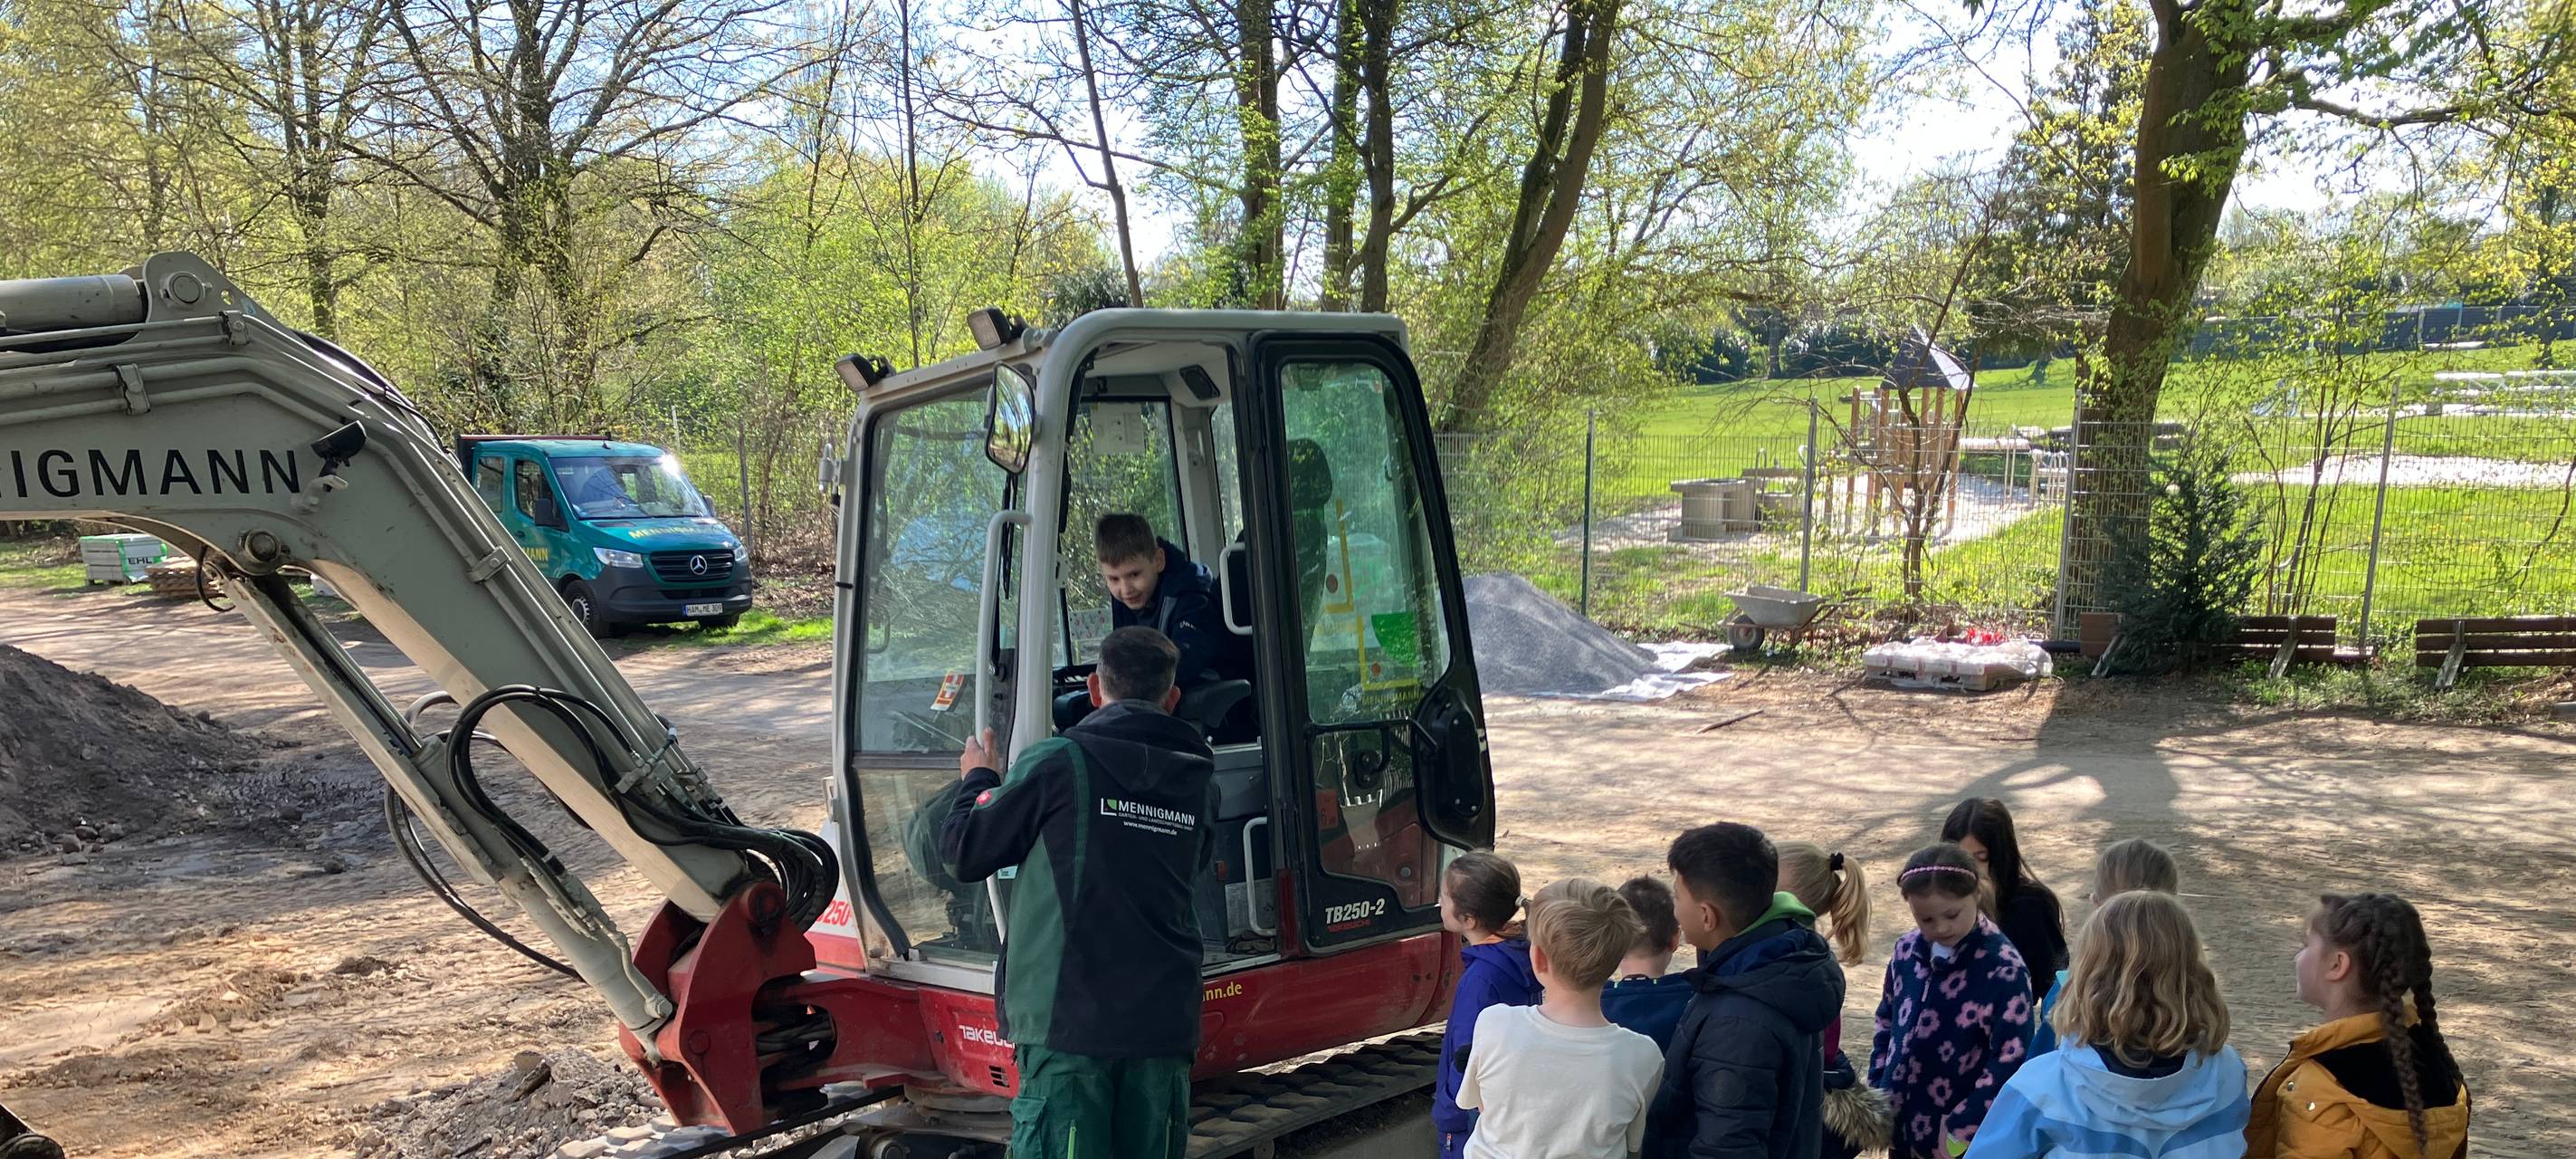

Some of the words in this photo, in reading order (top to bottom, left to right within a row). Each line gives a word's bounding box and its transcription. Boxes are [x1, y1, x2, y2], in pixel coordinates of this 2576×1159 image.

[0, 449, 301, 497] IGMANN
[128, 556, 153, 565] EHL
[1118, 800, 1196, 827] MENNIGMANN
[1122, 820, 1178, 836] www.mennigmann.de
[1324, 897, 1386, 924] TB250-2
[958, 1024, 1016, 1049] TAKEU
